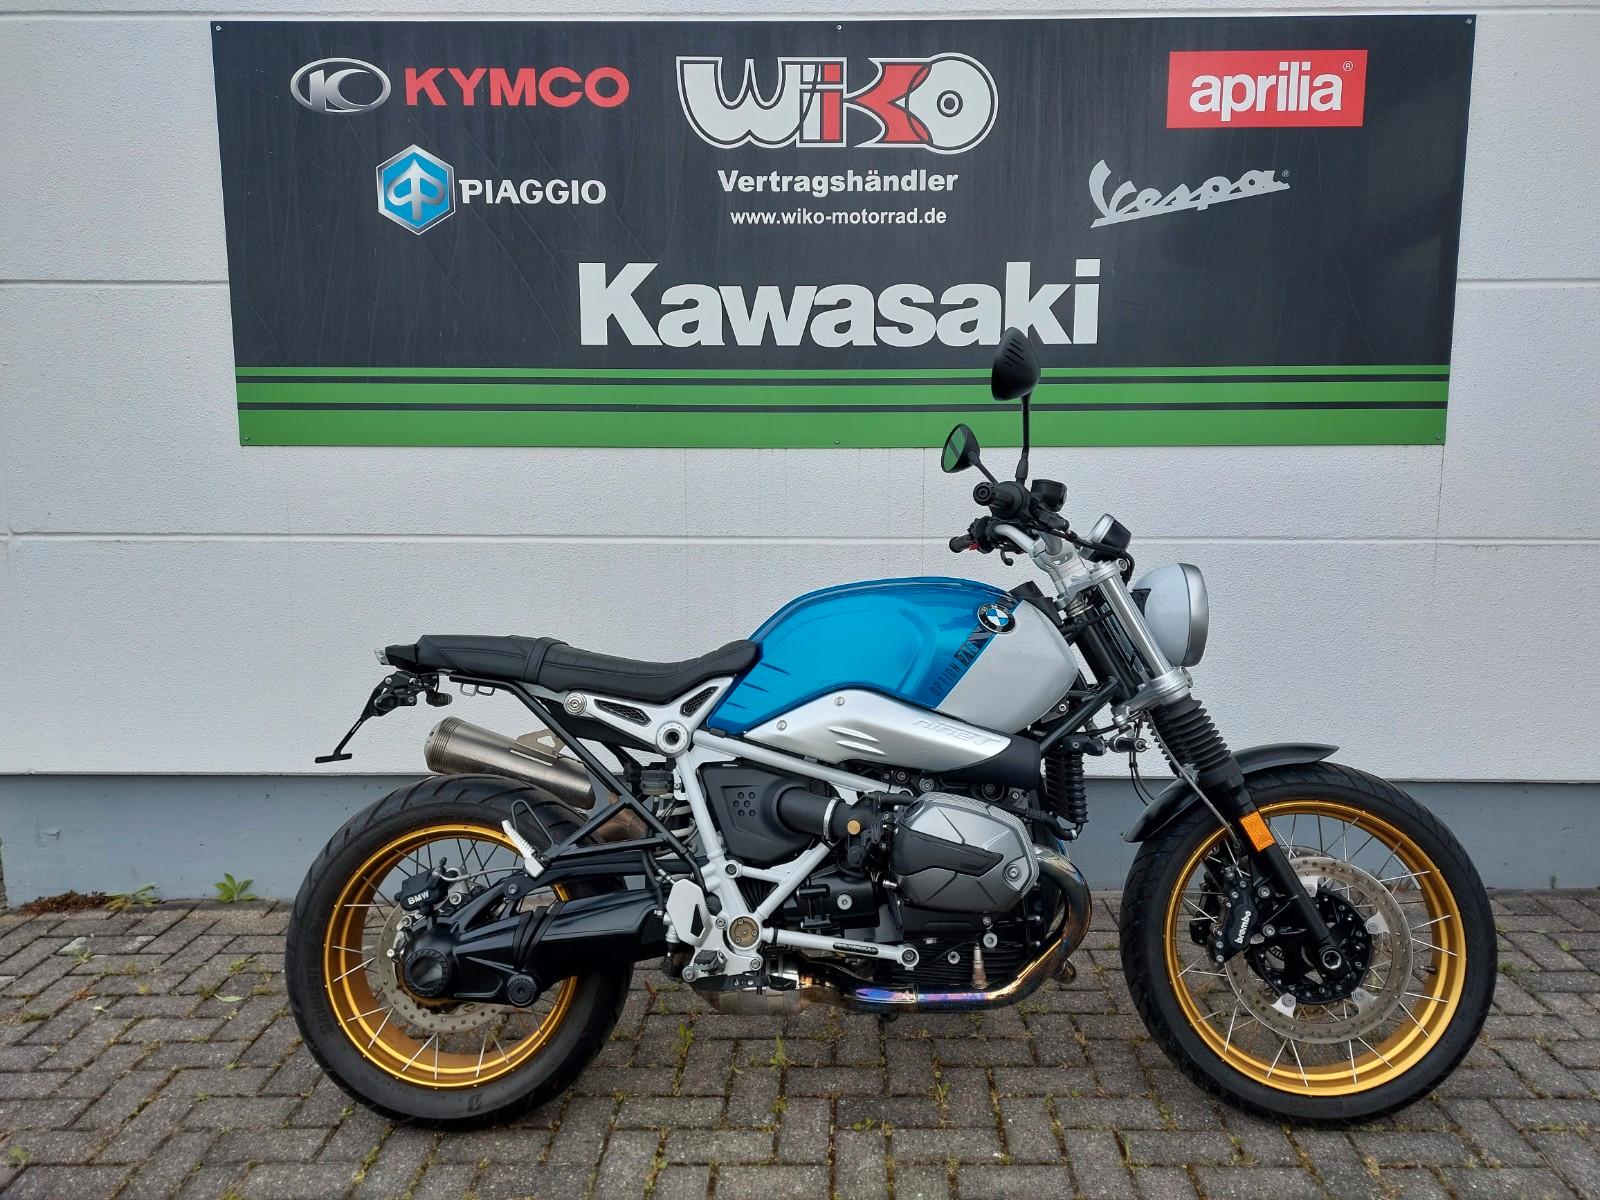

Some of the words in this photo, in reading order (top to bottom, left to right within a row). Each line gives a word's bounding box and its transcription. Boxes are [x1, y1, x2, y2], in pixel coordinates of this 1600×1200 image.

[404, 66, 630, 107] KYMCO
[1189, 61, 1343, 121] aprilia
[459, 178, 607, 205] PIAGGIO
[717, 169, 958, 198] Vertragshändler
[1089, 159, 1291, 228] Vespa
[730, 207, 947, 225] www.wiko-motorrad.de
[578, 258, 1100, 348] Kawasaki
[407, 890, 429, 905] BMW
[1234, 910, 1252, 944] brembo
